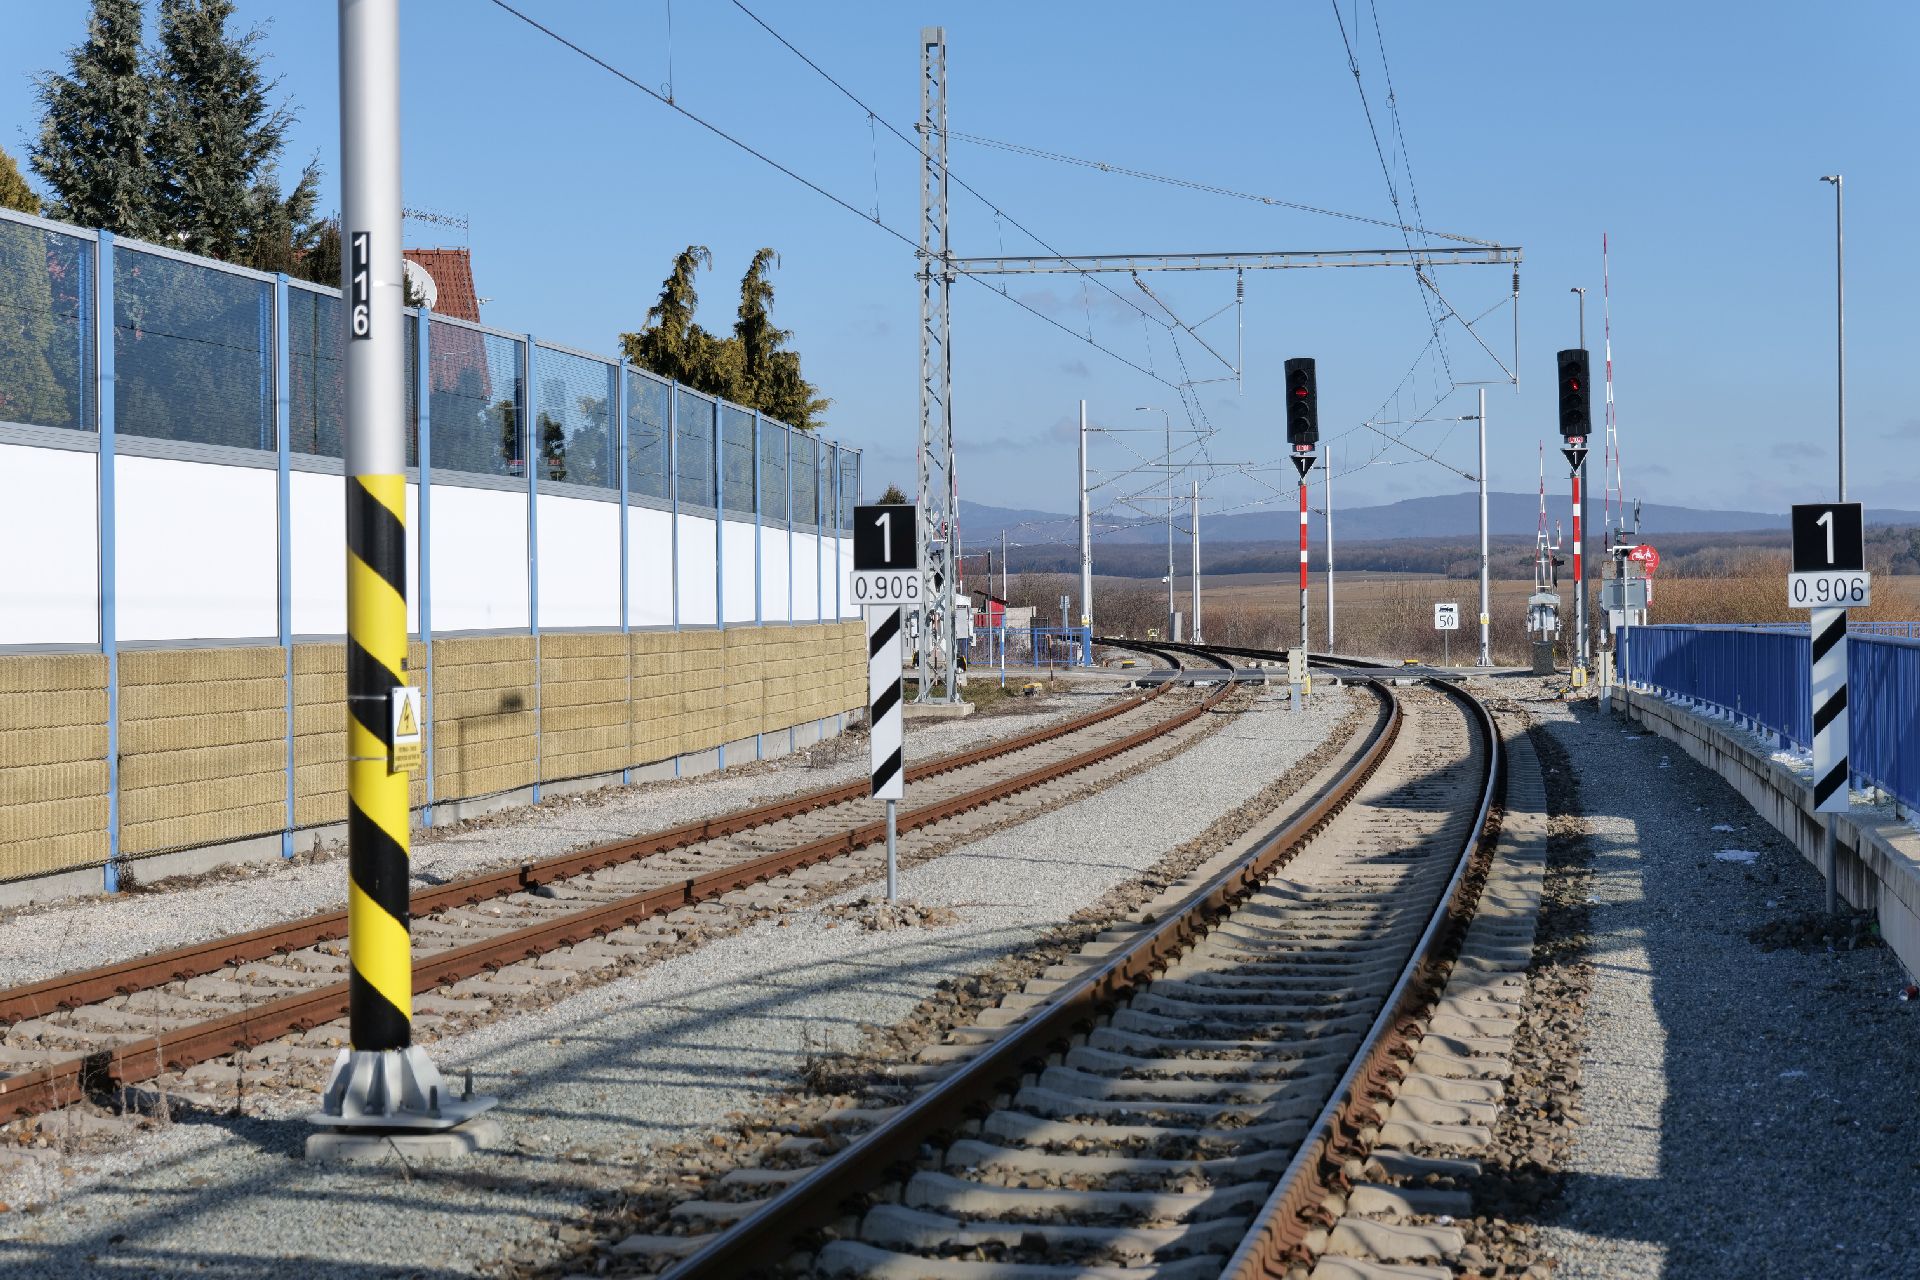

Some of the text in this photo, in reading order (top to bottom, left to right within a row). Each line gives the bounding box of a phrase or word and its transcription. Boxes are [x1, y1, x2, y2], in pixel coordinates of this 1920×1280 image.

[353, 233, 369, 336] 116
[1300, 458, 1306, 472] 1
[1572, 451, 1577, 465] 1
[874, 512, 891, 563] 1
[1815, 511, 1834, 564] 1
[855, 576, 918, 599] 0.906
[1794, 578, 1864, 602] 0.906
[1439, 614, 1454, 628] 50
